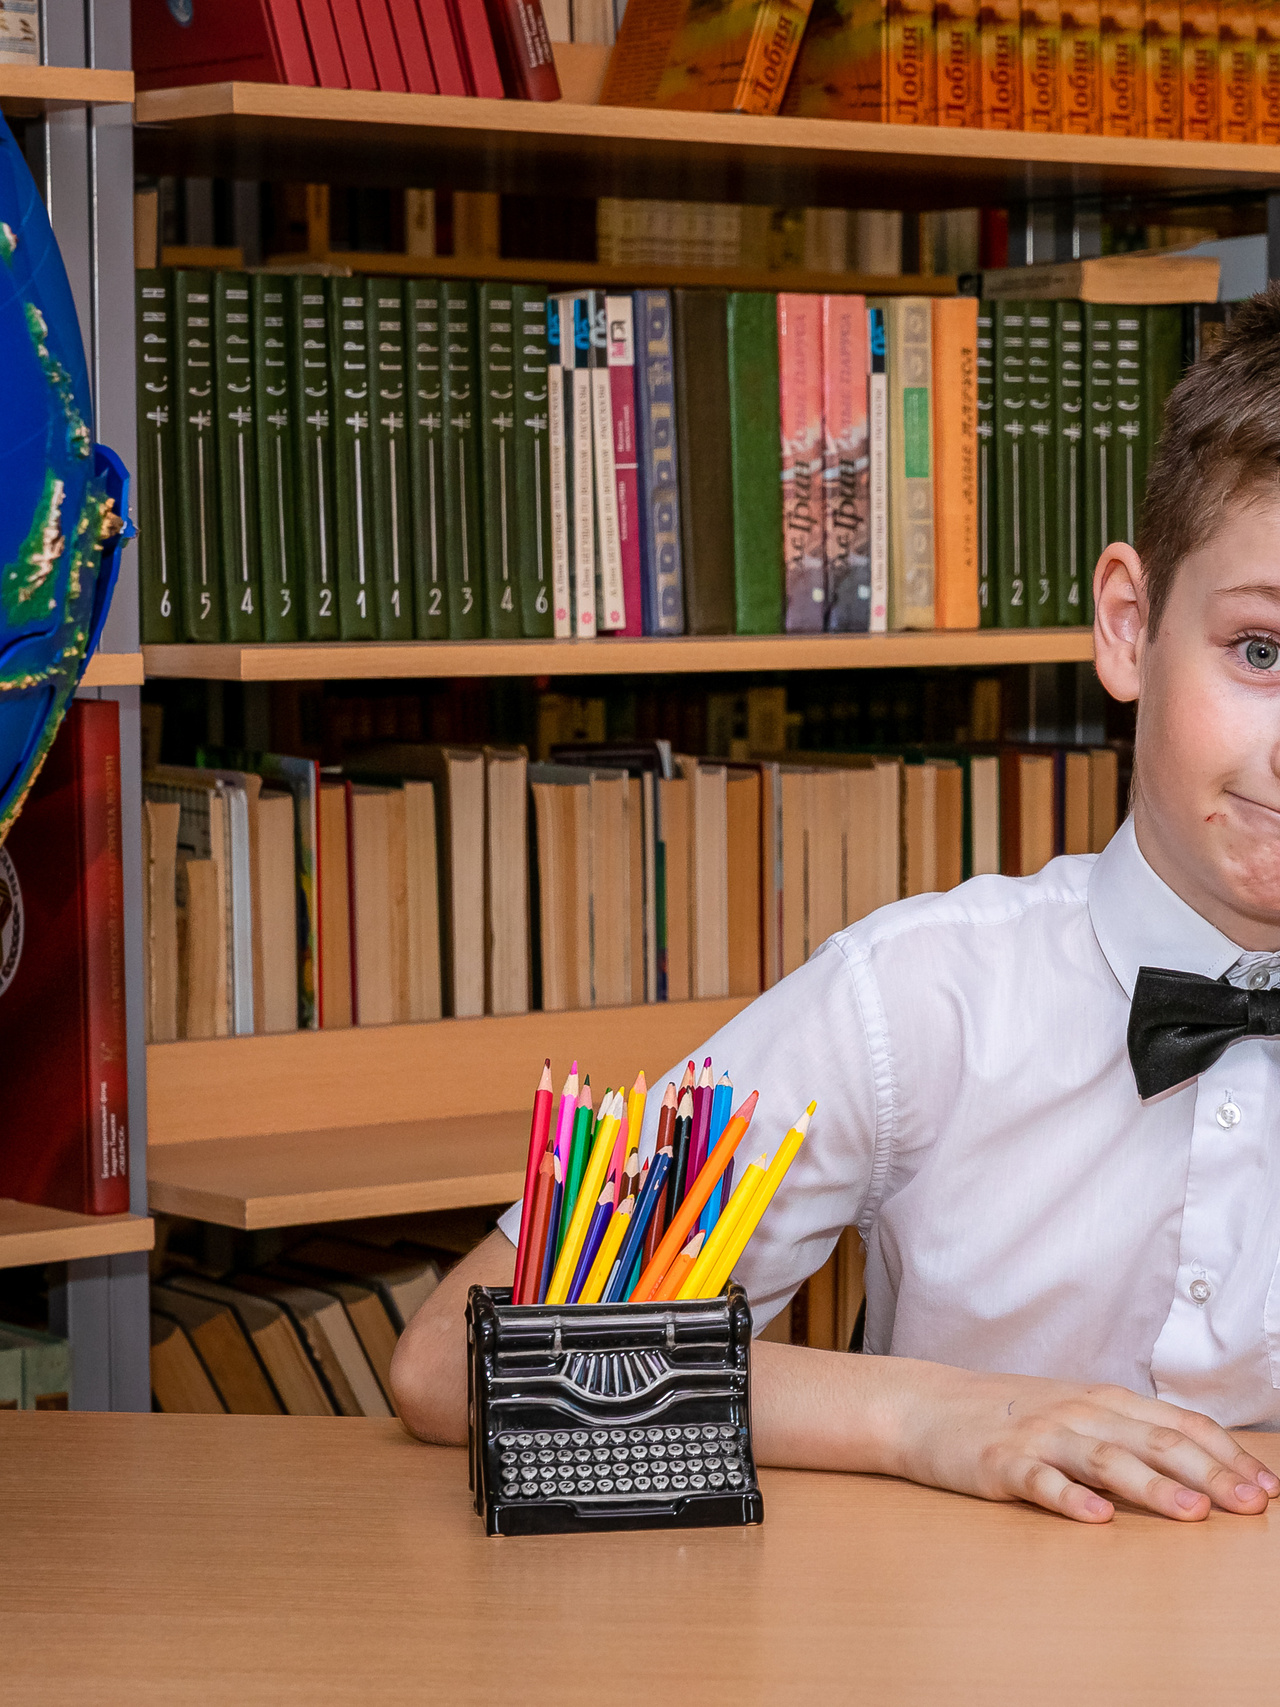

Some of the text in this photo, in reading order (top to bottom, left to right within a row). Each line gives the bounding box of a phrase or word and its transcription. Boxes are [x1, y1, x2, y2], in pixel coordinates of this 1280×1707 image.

[752, 15, 793, 110] Лобня
[897, 28, 918, 123] Лобня
[945, 32, 966, 127] Лобня
[989, 35, 1010, 129] Лобня
[1031, 38, 1050, 131] Лобня
[1067, 41, 1089, 133] Лобня
[1110, 44, 1129, 134] Лобня
[1154, 48, 1173, 139] Лобня
[1189, 50, 1208, 140] Лобня
[1226, 52, 1246, 141] Лобня
[1261, 54, 1280, 143] Лобня
[160, 588, 171, 618] 6
[200, 592, 211, 620] 5
[240, 586, 254, 615] 4
[280, 588, 292, 617] 3
[319, 588, 332, 617] 2
[356, 589, 367, 618] 1
[391, 589, 401, 617] 1
[428, 587, 442, 616] 2
[461, 586, 474, 615] 3
[500, 585, 514, 612] 4
[535, 585, 549, 614] 6
[978, 581, 989, 608] 1
[1010, 579, 1024, 607] 2
[1038, 578, 1050, 605] 3
[1067, 582, 1080, 607] 4
